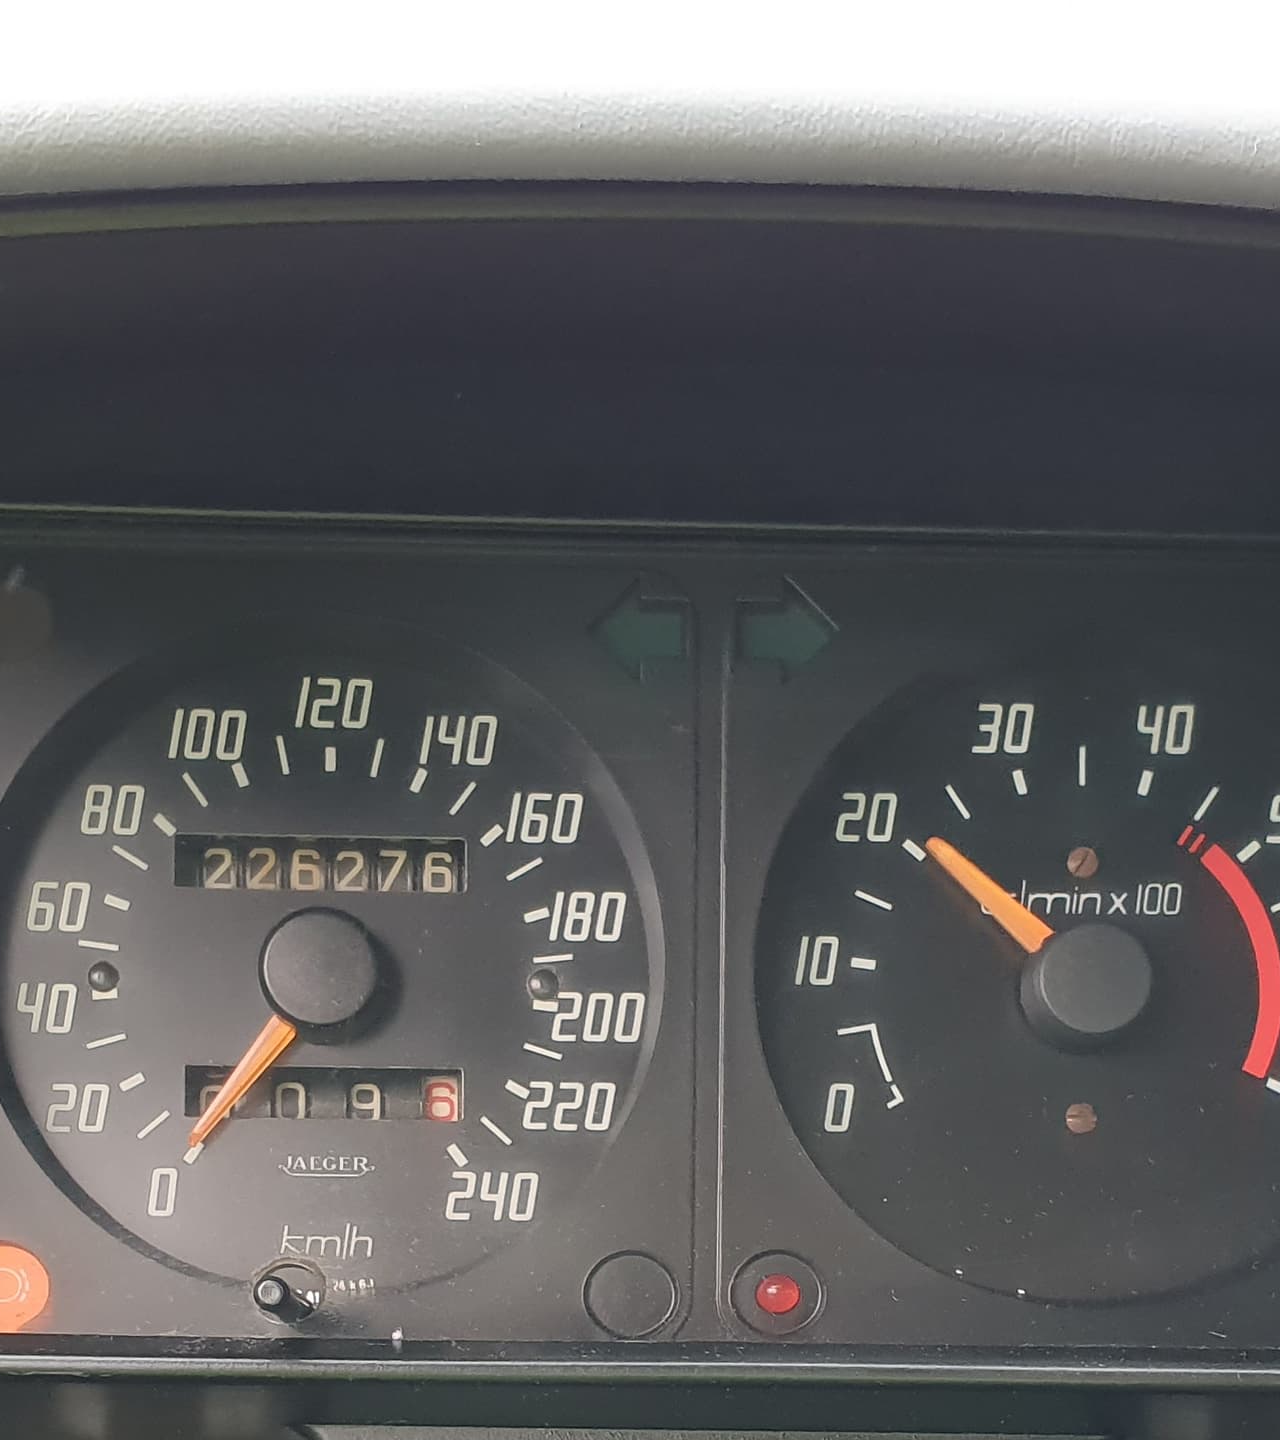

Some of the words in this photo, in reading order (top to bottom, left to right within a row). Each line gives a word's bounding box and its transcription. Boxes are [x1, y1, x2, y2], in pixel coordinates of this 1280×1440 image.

[295, 677, 373, 729] 120
[167, 709, 247, 761] 100
[420, 715, 498, 766] 140
[971, 703, 1034, 755] 30
[1136, 704, 1195, 756] 40
[81, 785, 145, 836] 80
[505, 792, 584, 845] 160
[835, 792, 898, 843] 20
[203, 849, 455, 894] 226276
[27, 882, 91, 932] 60
[549, 892, 627, 942] 180
[1135, 883, 1182, 916] 100
[794, 936, 840, 986] 10
[16, 983, 77, 1034] 40
[551, 992, 646, 1044] 200
[46, 1084, 110, 1133] 20
[522, 1083, 617, 1132] 220
[824, 1083, 855, 1133] 0
[285, 1155, 371, 1173] JAEGER
[147, 1168, 178, 1217] 0
[445, 1172, 540, 1222] 240
[279, 1222, 373, 1260] km/h
